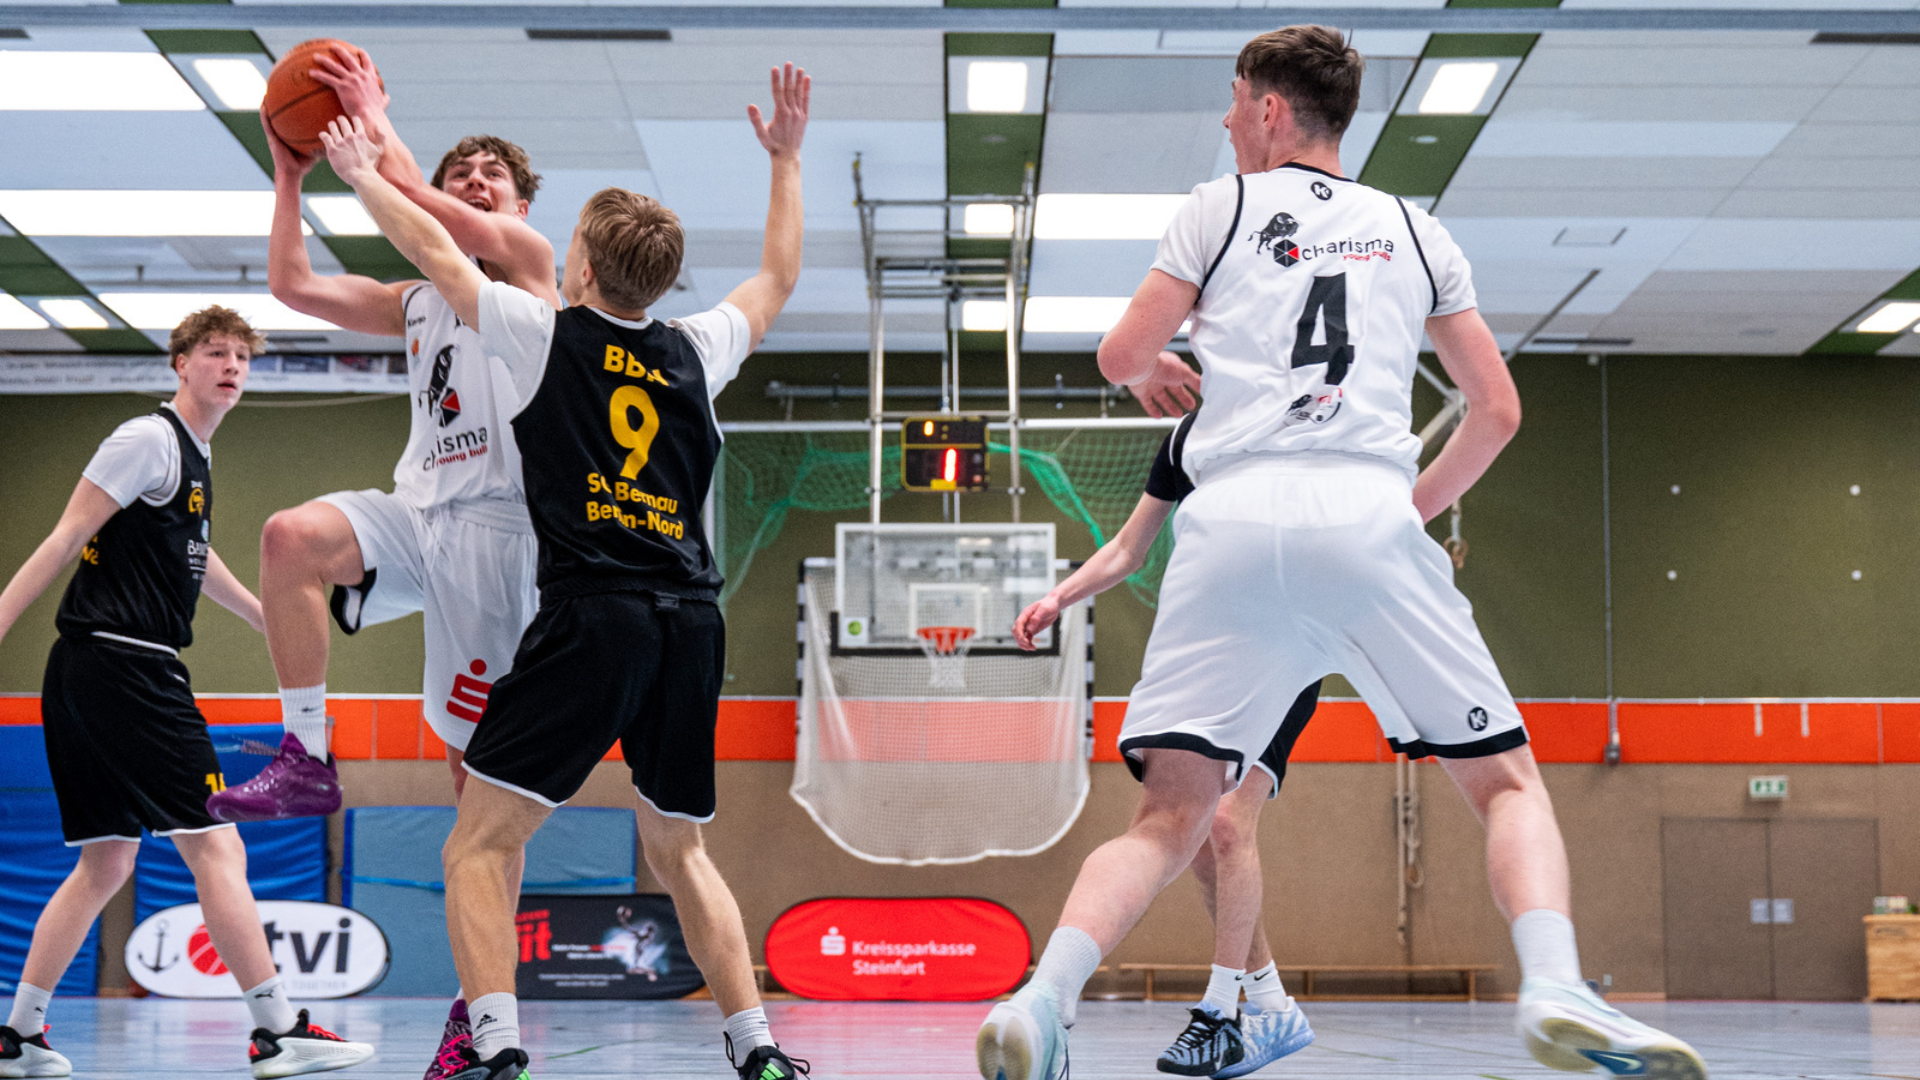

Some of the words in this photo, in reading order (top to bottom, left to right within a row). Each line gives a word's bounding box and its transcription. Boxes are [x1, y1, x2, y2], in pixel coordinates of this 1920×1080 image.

[1302, 237, 1394, 261] charisma
[1291, 272, 1355, 386] 4
[609, 385, 660, 480] 9
[614, 481, 678, 514] Bernau
[263, 917, 352, 973] tvi
[515, 921, 552, 963] it
[852, 941, 976, 957] Kreissparkasse
[852, 959, 926, 976] Steinfurt
